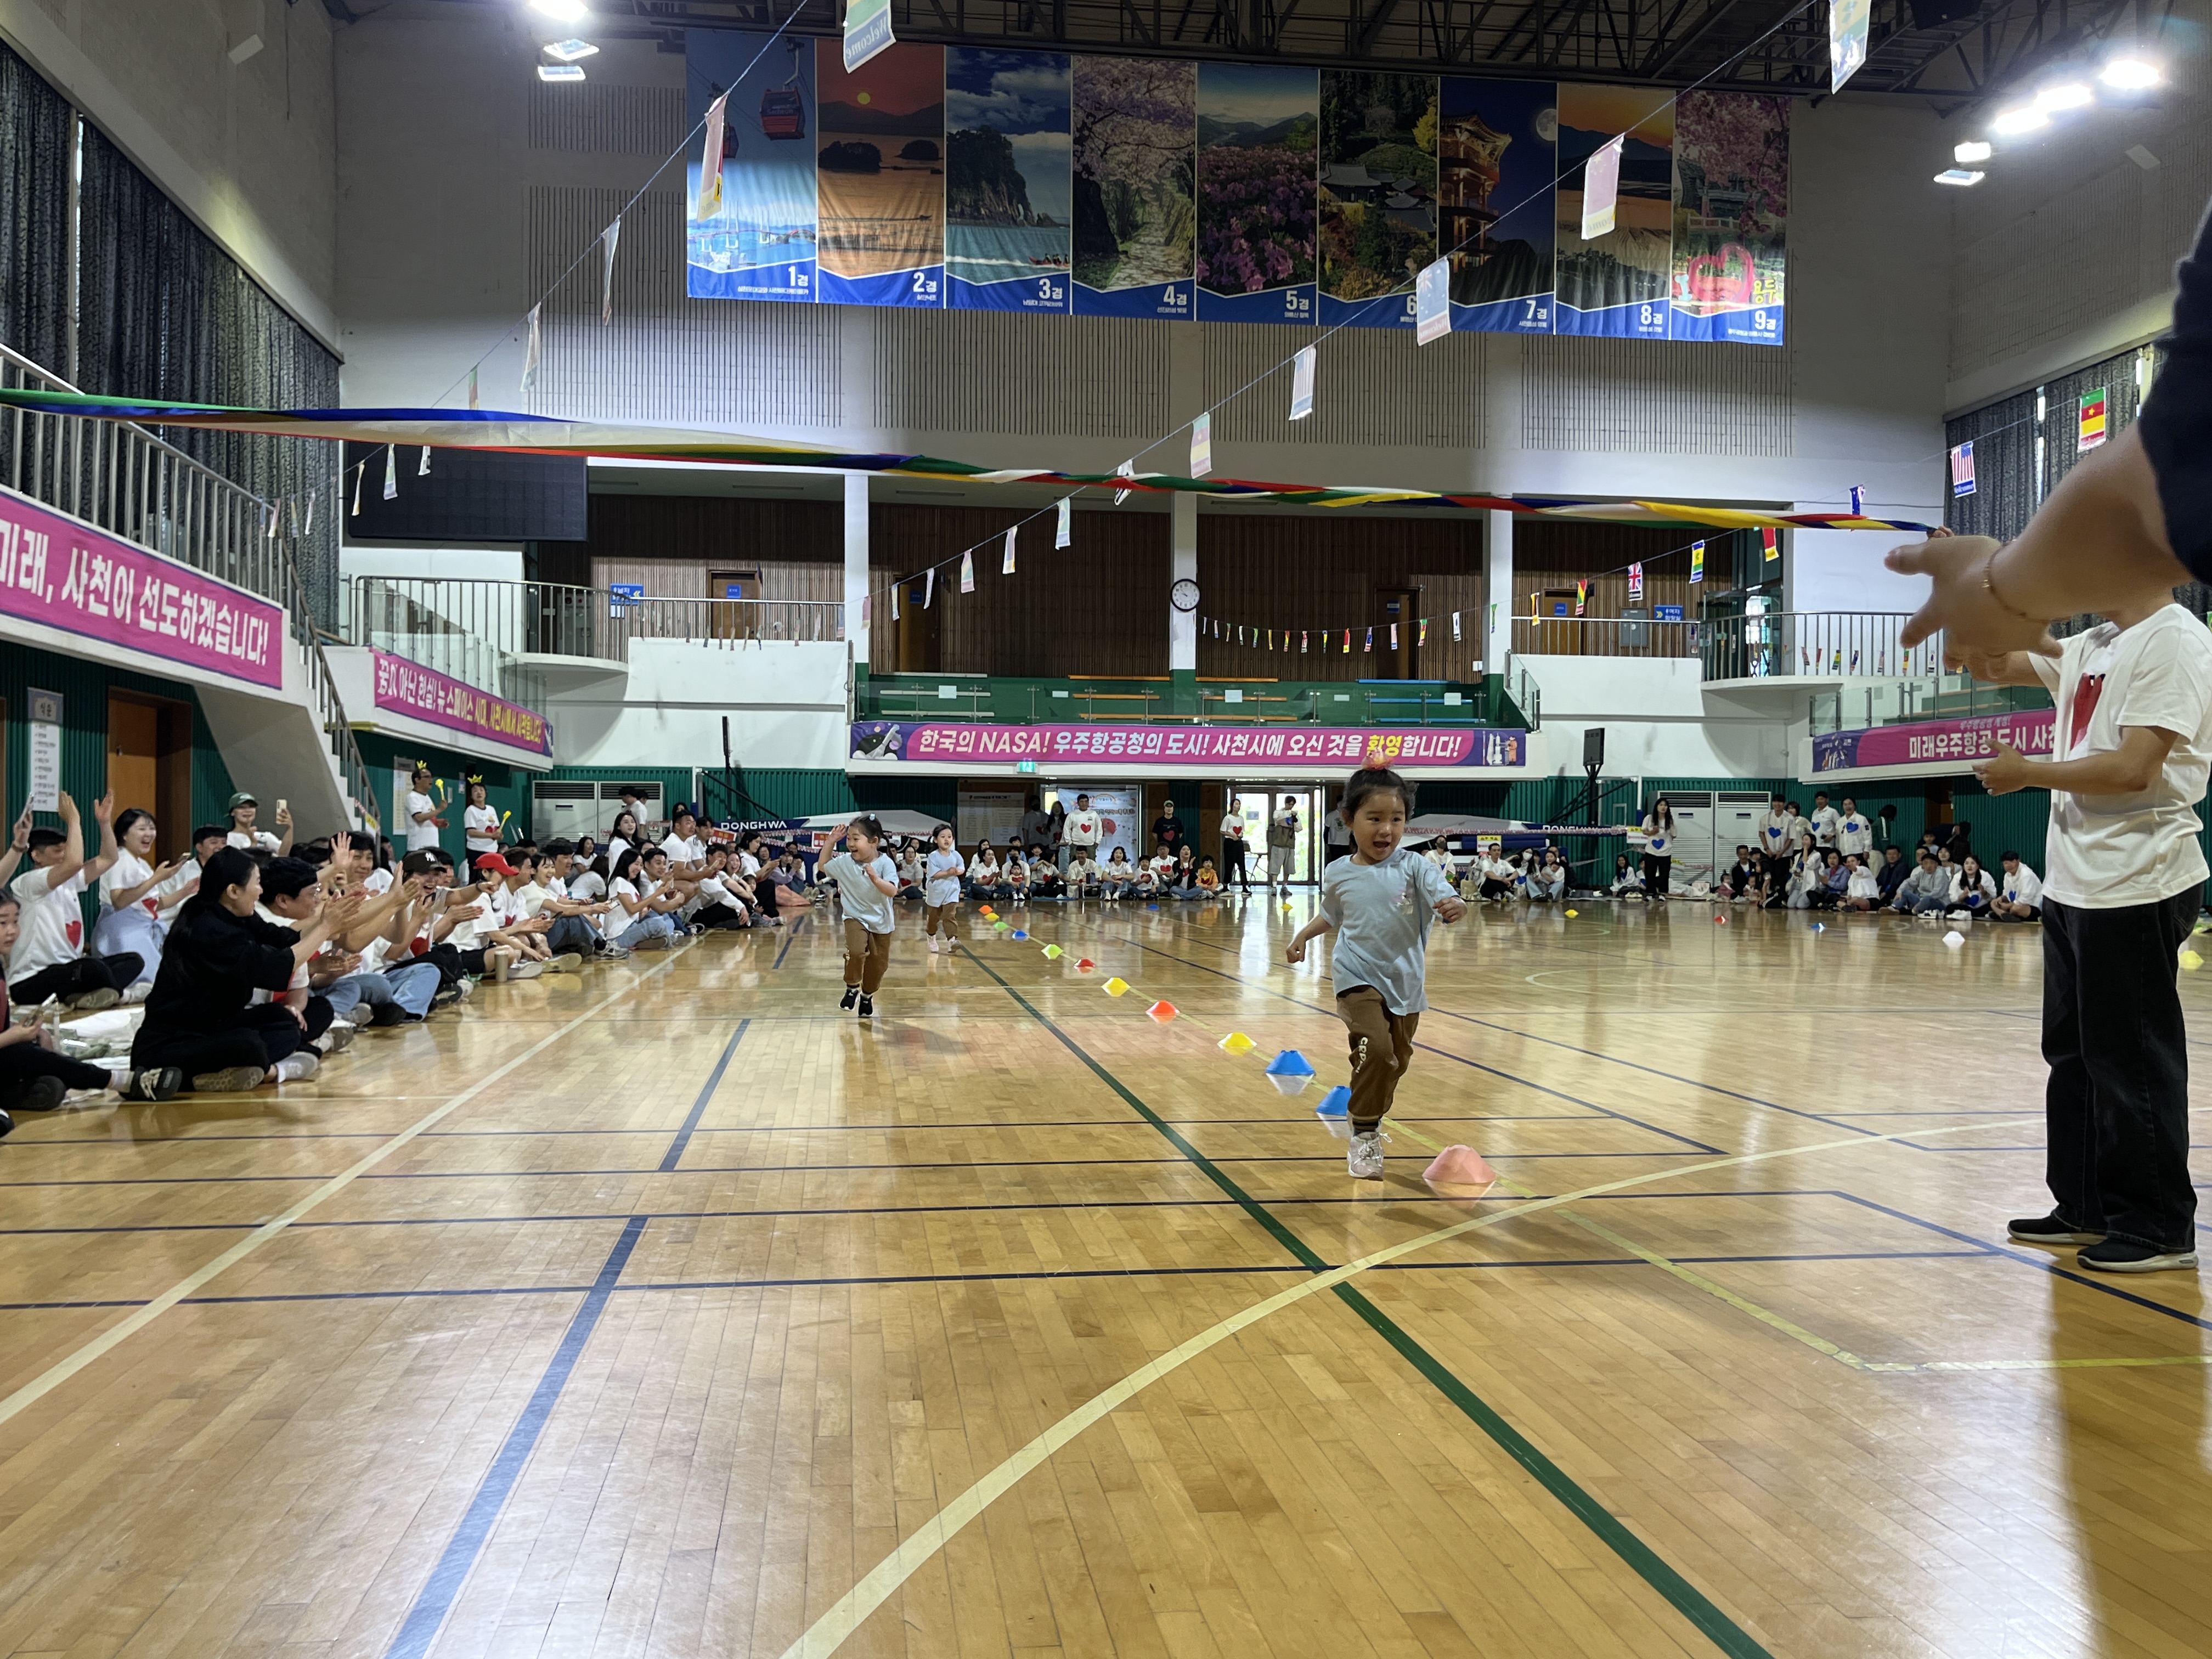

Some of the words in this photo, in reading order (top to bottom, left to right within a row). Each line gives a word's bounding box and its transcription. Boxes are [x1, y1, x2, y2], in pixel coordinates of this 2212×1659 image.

[788, 266, 809, 287] 1경
[913, 272, 937, 293] 2경
[1039, 278, 1063, 300] 3경
[1163, 285, 1187, 306] 4경
[1753, 279, 1776, 304] 용두
[1286, 290, 1309, 311] 5경
[1526, 300, 1547, 319] 7경
[1640, 304, 1663, 325] 8경
[1754, 310, 1776, 330] 9경
[61, 547, 133, 624] 사천이
[139, 574, 269, 666] 선도하겠습니다!
[377, 658, 398, 698] 꿈이
[399, 666, 417, 704] 아닌
[417, 673, 437, 711] 현실!
[437, 681, 445, 714] 뉴
[446, 686, 473, 721] 스페이스
[475, 697, 488, 730] 시대,
[918, 729, 976, 754] 한국의
[979, 731, 1050, 753] NASA!
[1054, 732, 1163, 755] 우주항공청의
[1165, 733, 1209, 756] 도시!
[1212, 733, 1284, 757] 사천시에
[1286, 735, 1323, 757] 오신
[1327, 735, 1363, 757] 것을
[1366, 735, 1462, 758] 환영합니다!
[721, 821, 787, 831] DONGHWA
